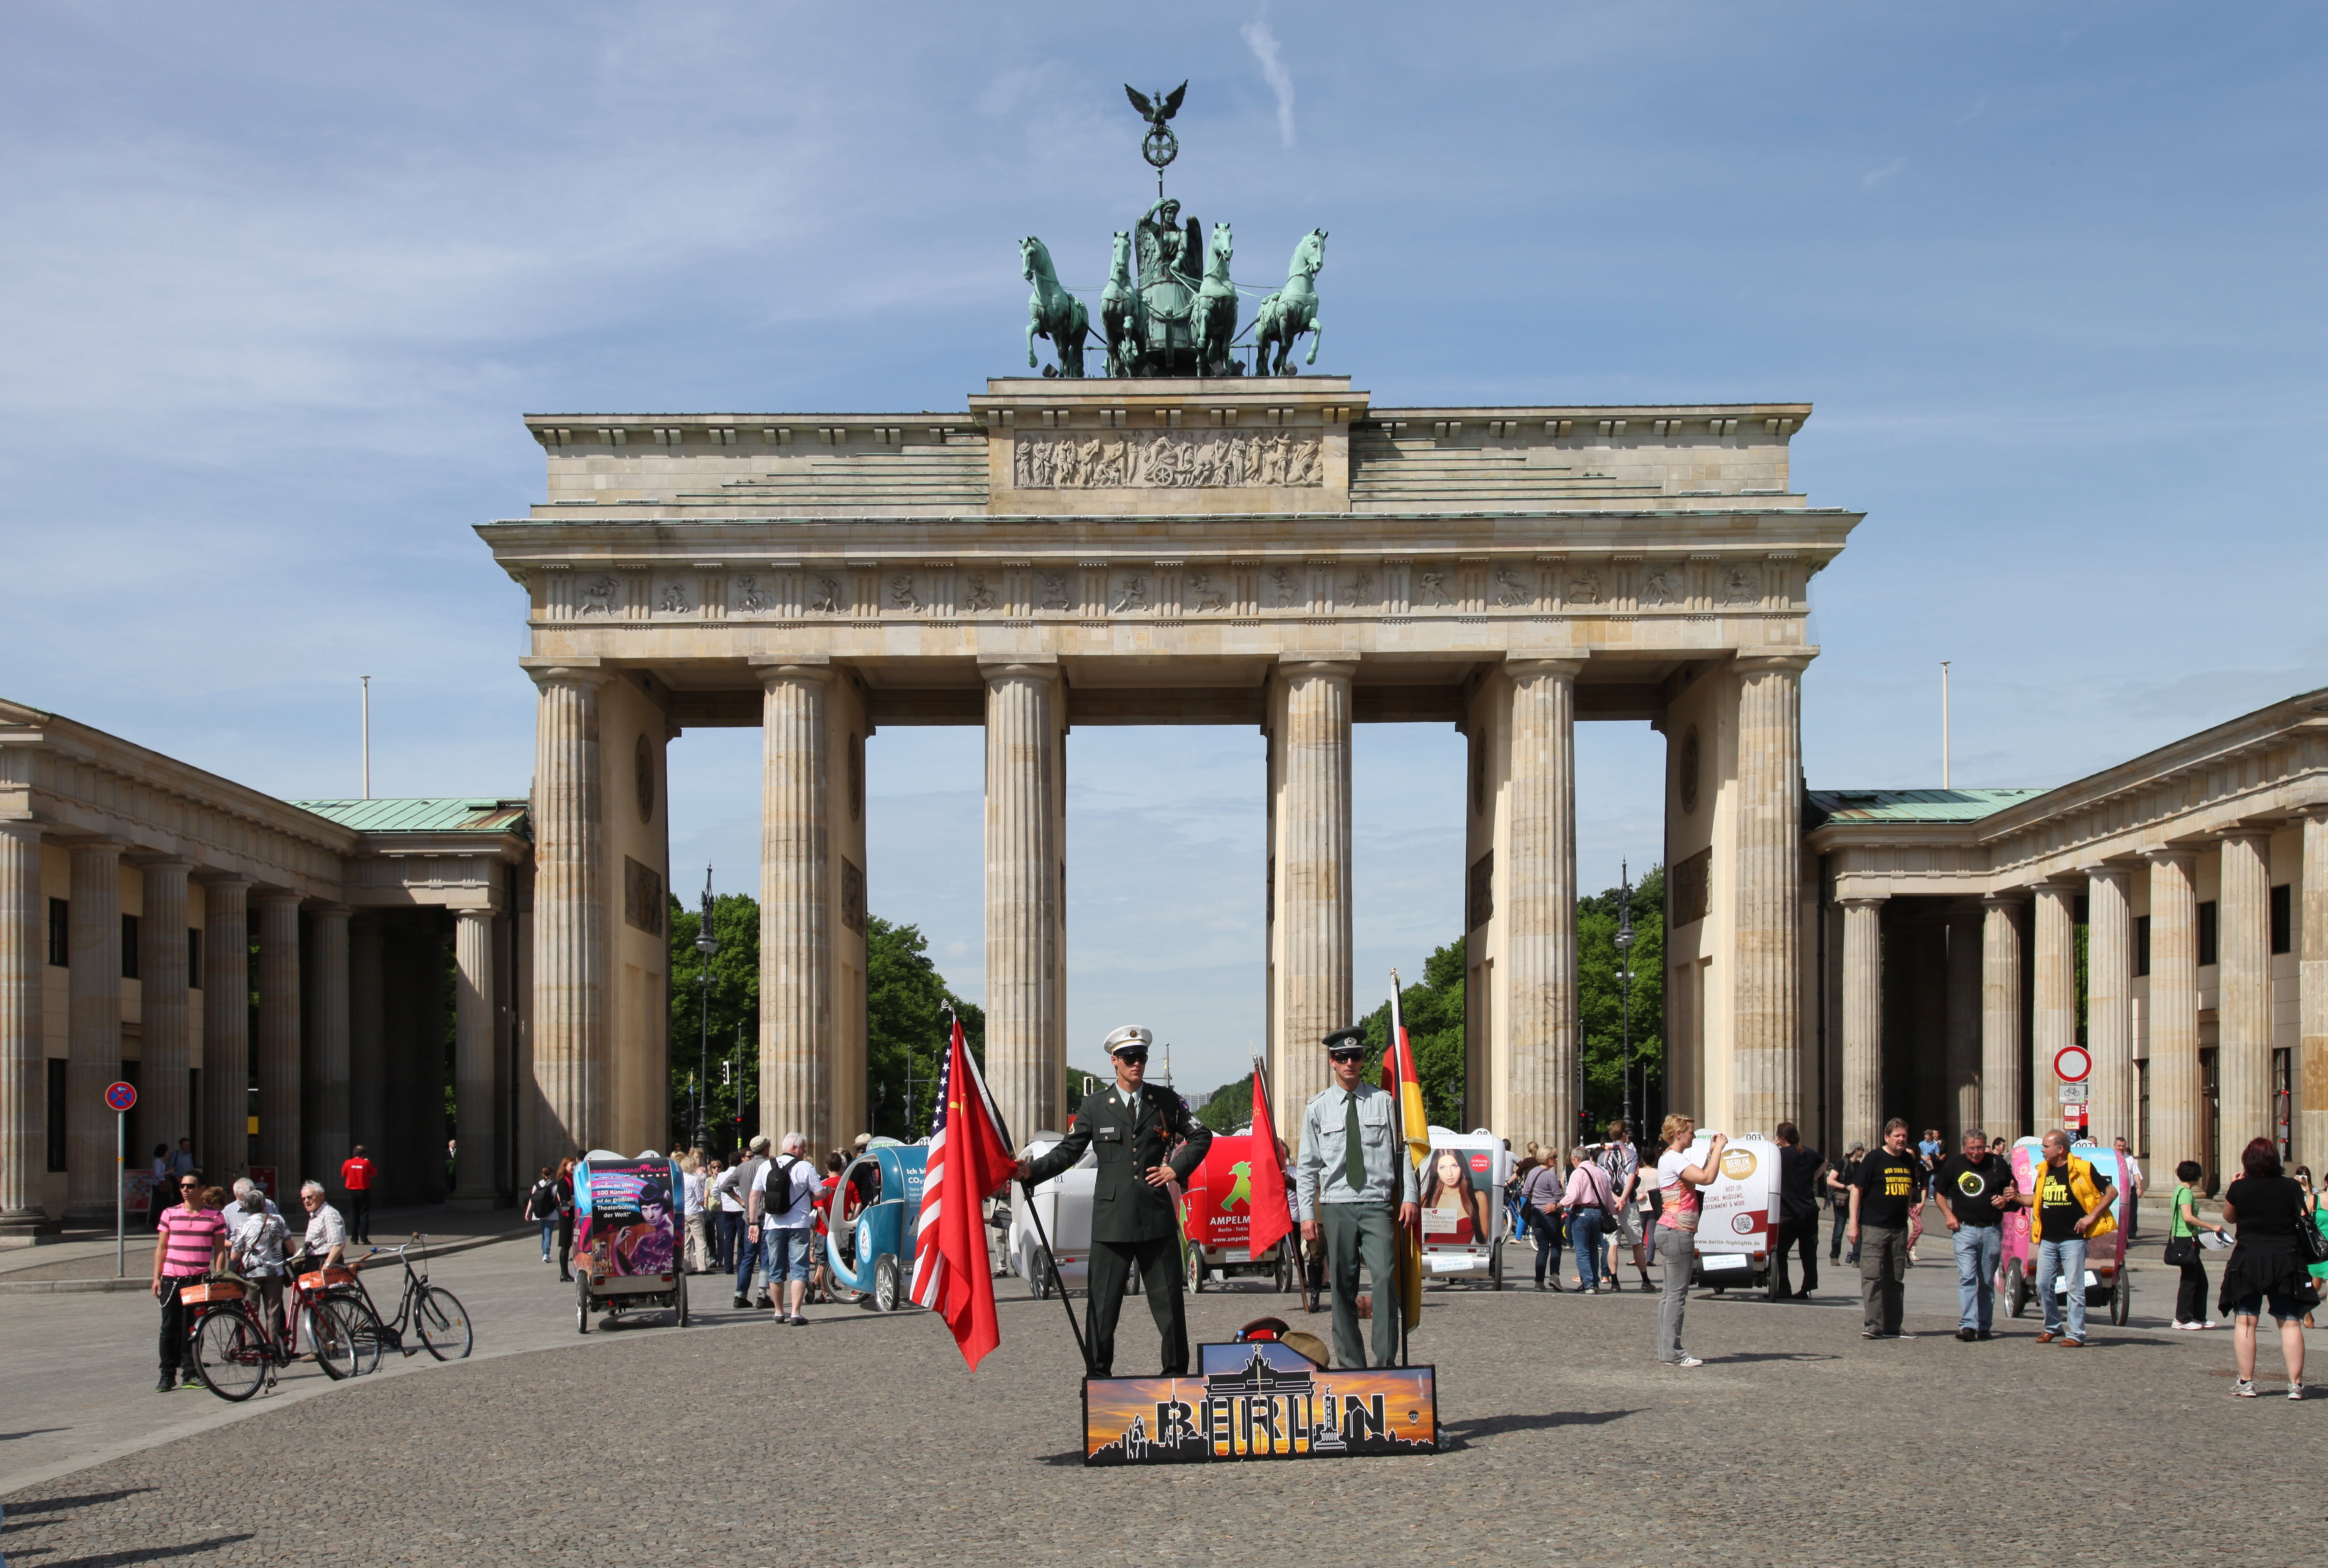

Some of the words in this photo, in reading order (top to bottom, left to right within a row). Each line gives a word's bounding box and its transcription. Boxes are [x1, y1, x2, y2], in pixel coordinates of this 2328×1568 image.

[1726, 1157, 1750, 1168] BERLIN
[1727, 1166, 1752, 1174] HIGHLIGHTS
[1885, 1183, 1911, 1196] JUNG
[1210, 1215, 1250, 1225] AMPELM
[1155, 1393, 1385, 1444] BERLIN
